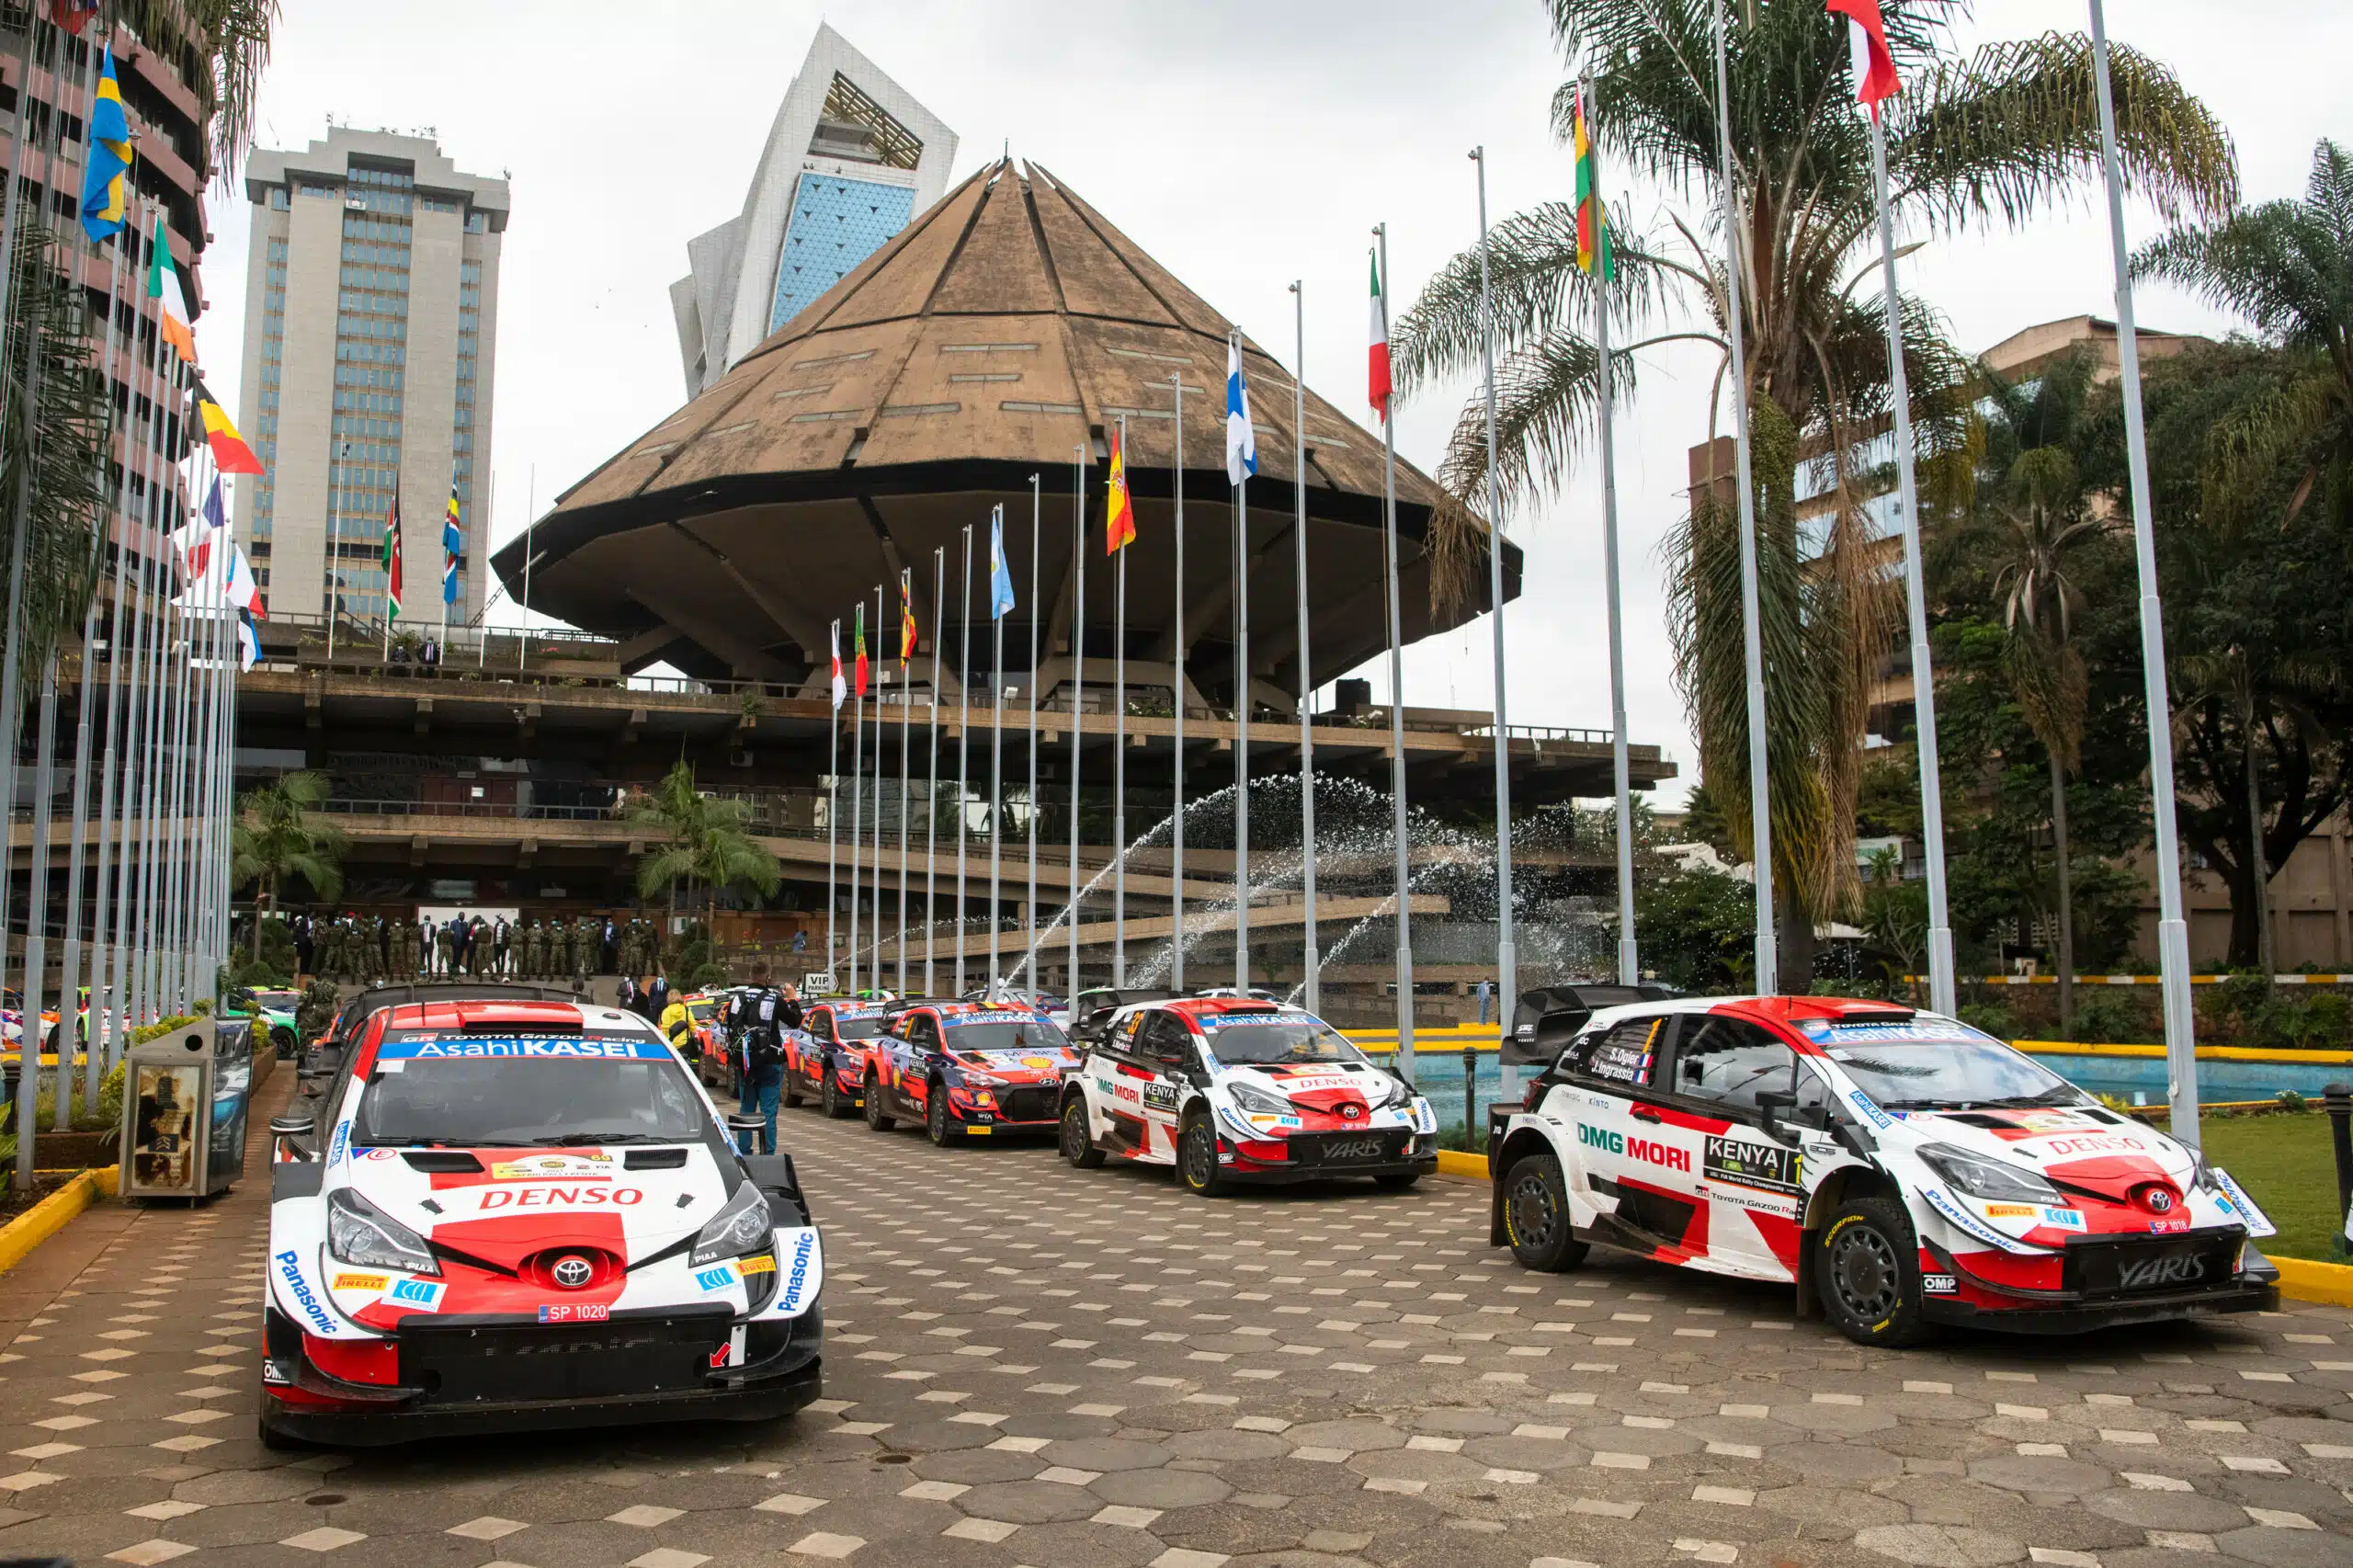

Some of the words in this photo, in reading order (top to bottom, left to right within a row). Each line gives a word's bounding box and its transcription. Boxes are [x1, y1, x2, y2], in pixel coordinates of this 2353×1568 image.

[811, 976, 829, 984] VIP
[587, 1035, 646, 1044] Racing
[1642, 1017, 1663, 1054] 1
[1609, 1048, 1639, 1067] S.Ogier
[1591, 1059, 1634, 1083] J.Ingrassia
[1145, 1082, 1176, 1100] KENYA
[1300, 1077, 1362, 1089] DENSO
[1114, 1084, 1140, 1106] MORI
[1221, 1107, 1263, 1139] Panasonic
[1627, 1136, 1691, 1173] MORI
[2048, 1137, 2146, 1155] DENSO
[1709, 1137, 1779, 1169] KENYA
[1793, 1153, 1802, 1185] 1
[478, 1187, 643, 1210] DENSO
[1711, 1192, 1745, 1204] TOYOTA
[1746, 1199, 1780, 1211] GAZOO
[1926, 1188, 2020, 1252] Panasonic
[1988, 1206, 2034, 1216] PIRELLI
[1824, 1214, 1866, 1248] SCORPION
[2155, 1221, 2167, 1233] SP
[2168, 1220, 2188, 1232] 1018
[695, 1251, 718, 1263] PIAA
[738, 1257, 774, 1273] PIRELLI
[406, 1261, 435, 1273] PIAA
[777, 1232, 814, 1312] Panasonic
[335, 1275, 386, 1289] PIRELLI
[1924, 1278, 1956, 1290] OMP
[275, 1249, 338, 1334] Panasonic
[550, 1306, 571, 1320] SP
[575, 1304, 608, 1319] 1020
